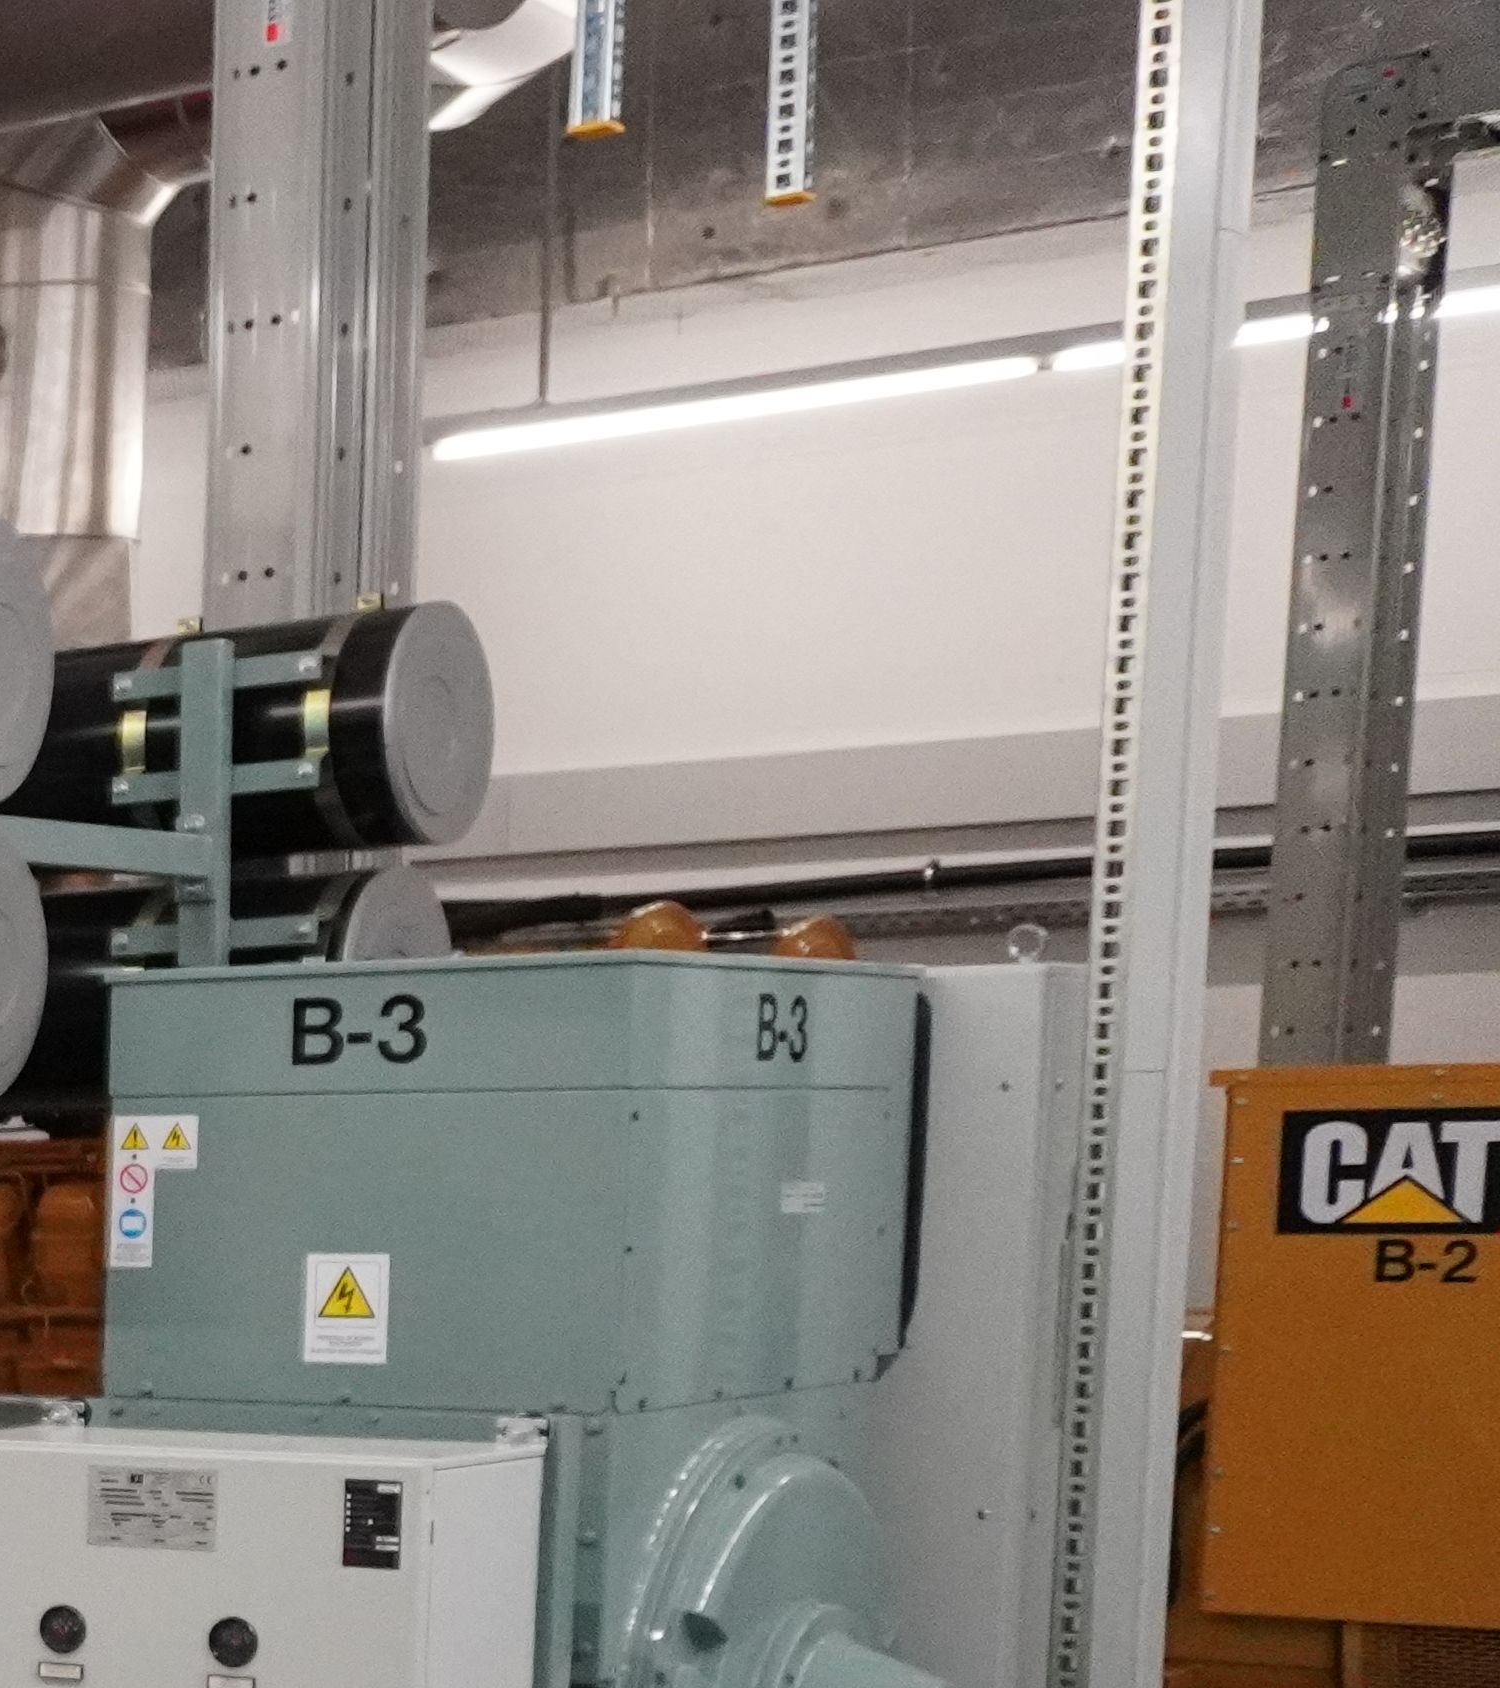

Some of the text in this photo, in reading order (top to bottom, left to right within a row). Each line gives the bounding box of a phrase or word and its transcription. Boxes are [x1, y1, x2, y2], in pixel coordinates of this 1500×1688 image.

[292, 994, 427, 1065] B-3
[756, 993, 808, 1063] B-3
[1299, 1120, 1500, 1225] CAT
[1374, 1239, 1480, 1284] B-2
